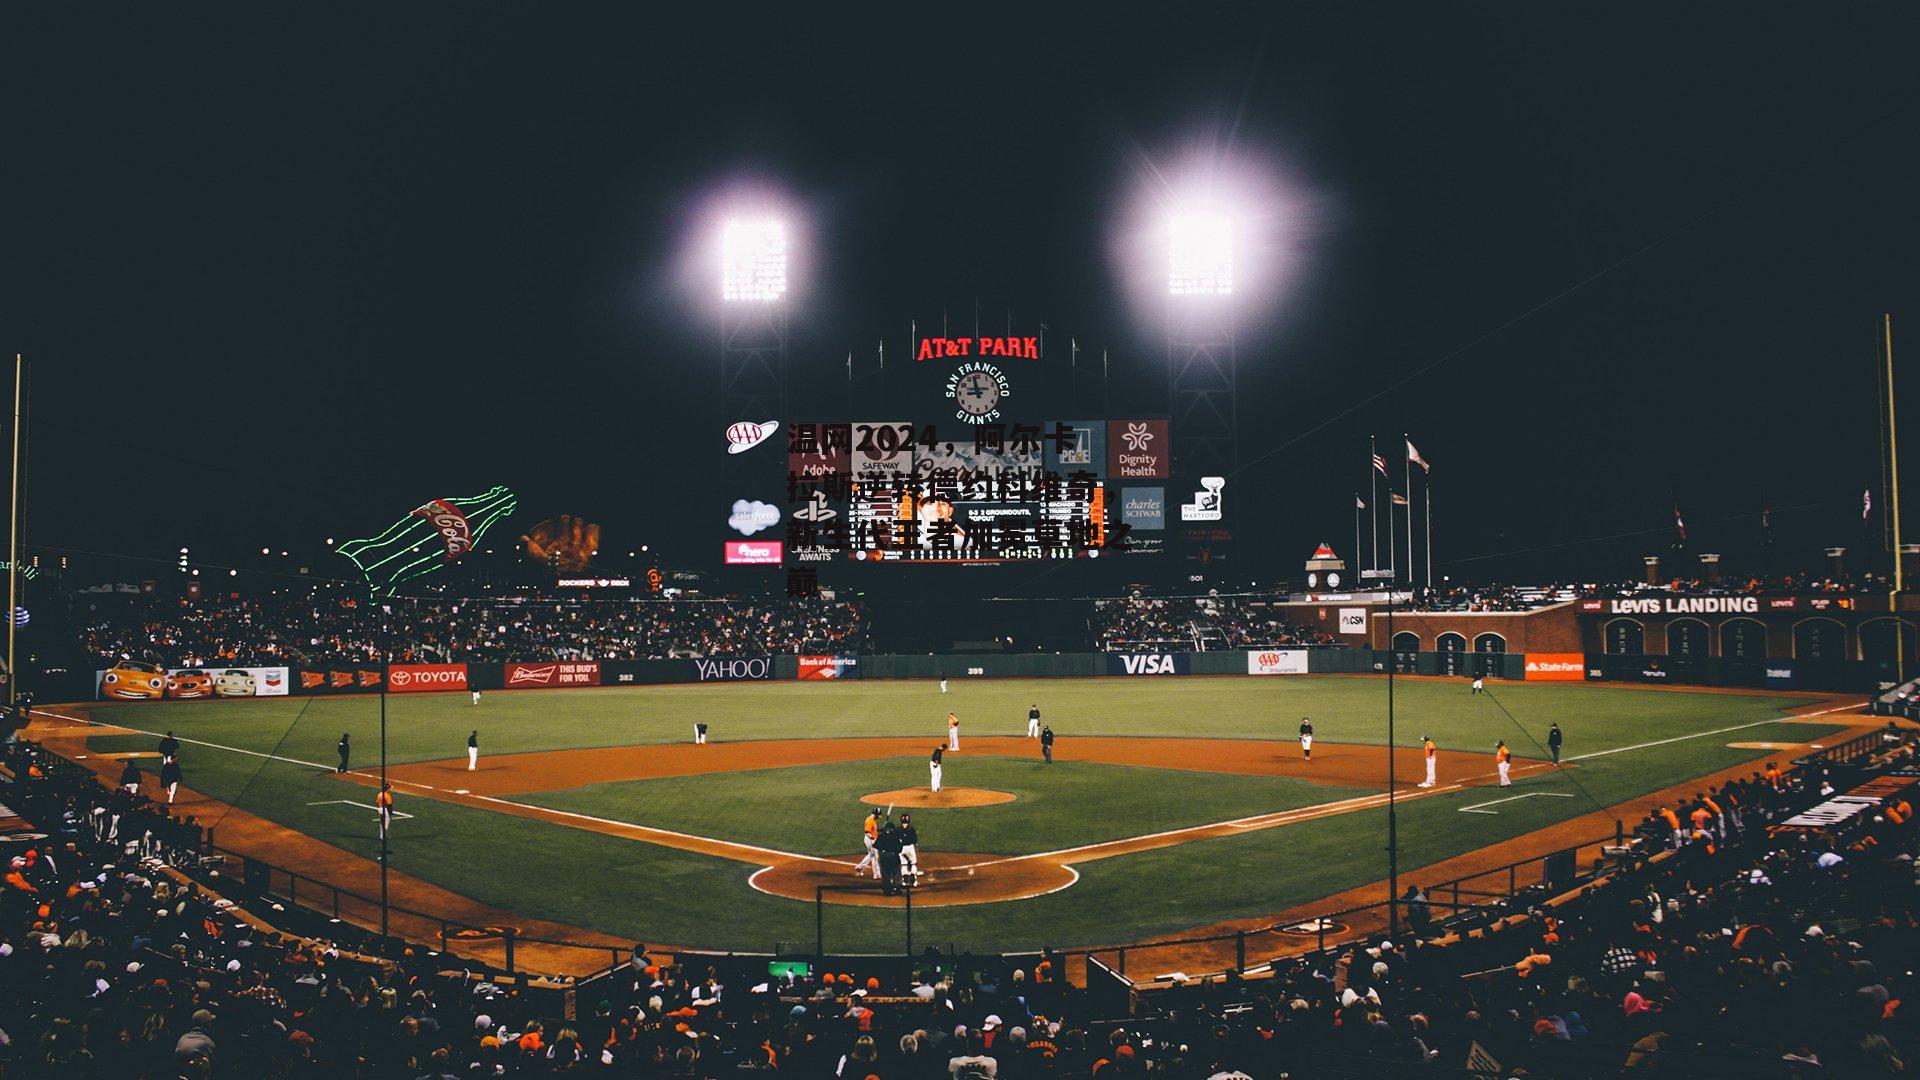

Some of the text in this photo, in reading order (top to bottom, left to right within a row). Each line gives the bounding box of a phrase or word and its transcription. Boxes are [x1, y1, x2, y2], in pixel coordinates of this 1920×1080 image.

[918, 337, 1038, 360] AT&T PARK
[946, 361, 1009, 398] SAN FRANCISCO
[956, 409, 1000, 425] GIANTS
[728, 425, 762, 442] AAA
[1119, 454, 1157, 467] Dignity
[802, 464, 835, 476] Adobe
[862, 462, 899, 470] SAFEWAY
[1121, 467, 1156, 476] Health
[1126, 499, 1160, 509] charles
[734, 511, 774, 521] salesforce
[799, 553, 832, 562] AWAITS
[558, 579, 630, 587] DOCKERS DECK
[1666, 597, 1758, 613] LANDING
[1349, 616, 1364, 625] CSN
[799, 658, 856, 666] Bank of America
[1118, 655, 1176, 674] VISA
[1258, 653, 1280, 666] AAA
[559, 664, 598, 673] THIS BUD'S
[695, 658, 770, 680] YAHOO!
[967, 667, 984, 675] 399
[1562, 662, 1584, 671] Farm
[413, 671, 467, 683] TOYOTA
[514, 670, 551, 679] Budweiser
[559, 673, 590, 682] FOR YOU.
